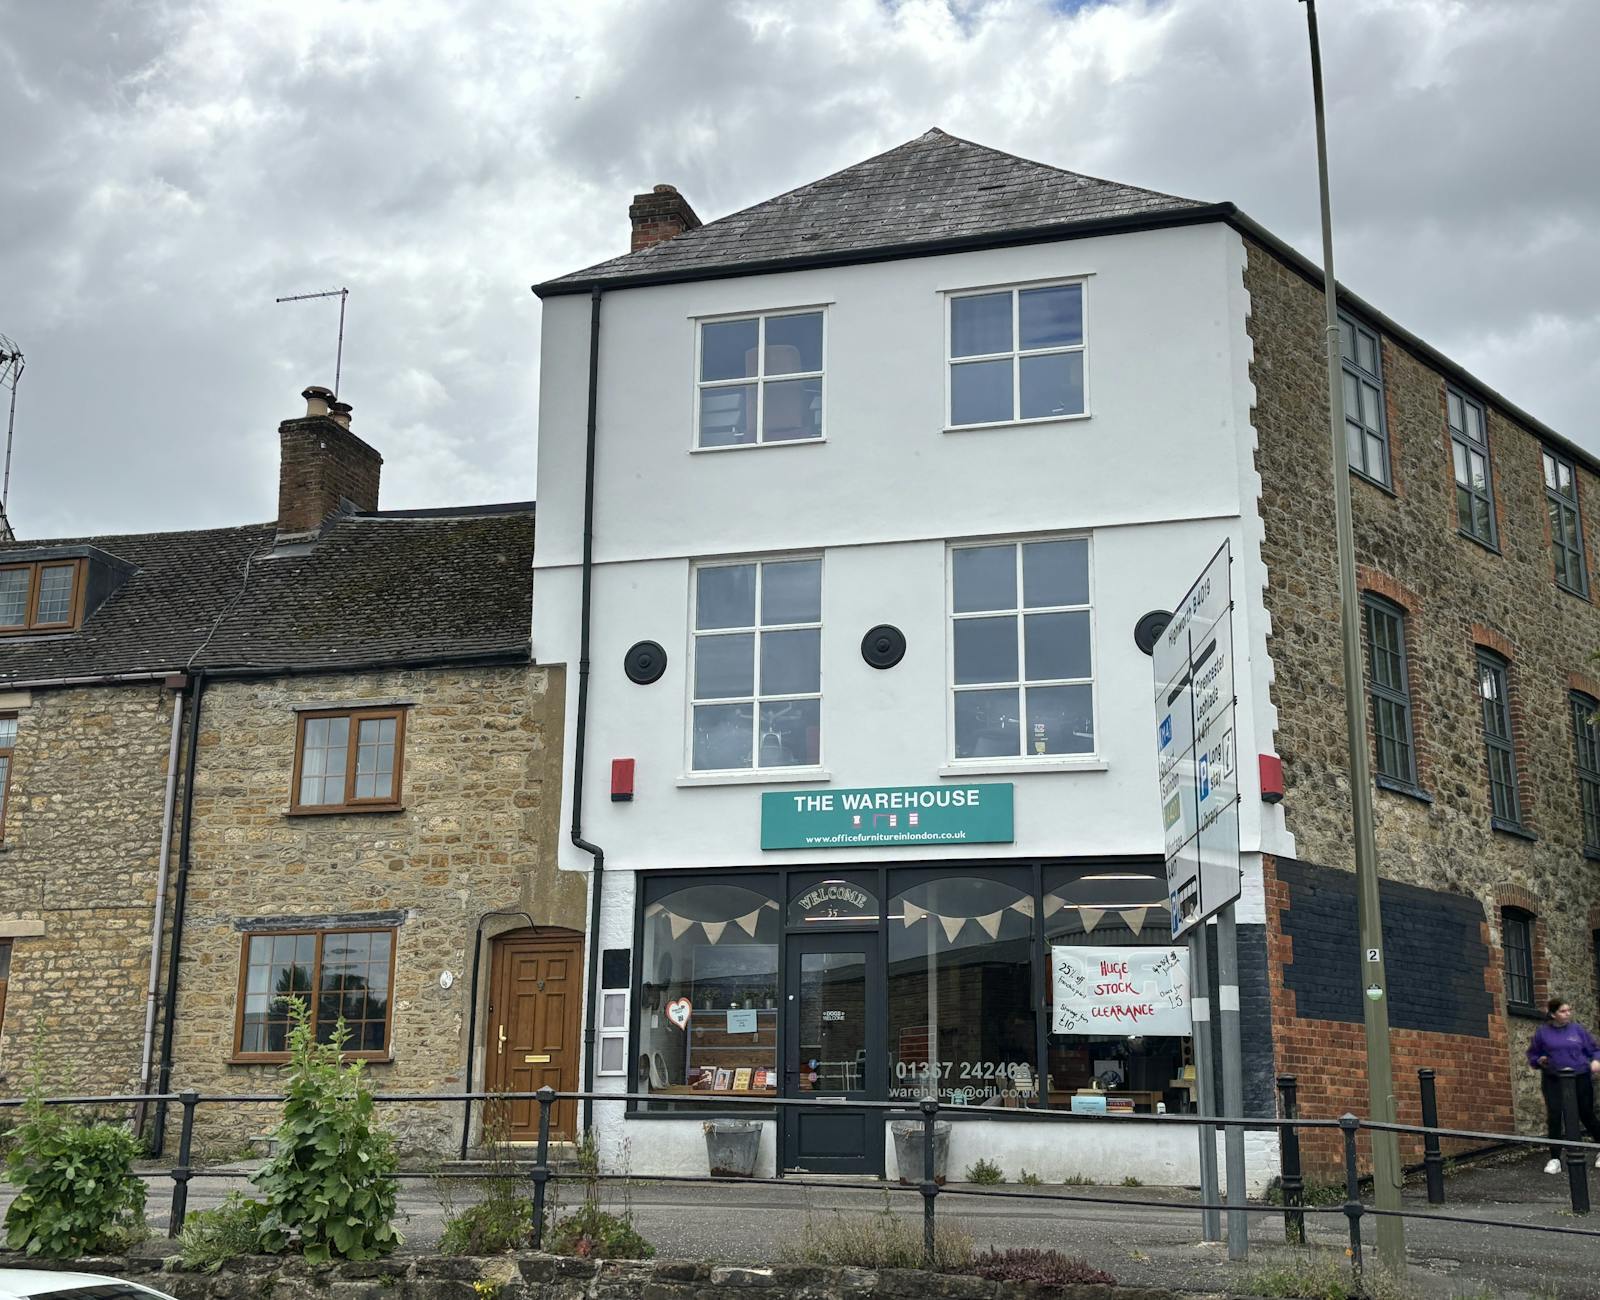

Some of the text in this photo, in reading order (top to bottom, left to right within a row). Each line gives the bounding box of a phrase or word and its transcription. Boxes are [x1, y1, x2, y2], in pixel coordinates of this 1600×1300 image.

[1196, 654, 1225, 698] Cirencester
[1209, 743, 1221, 766] Long
[1211, 768, 1221, 791] stay
[794, 790, 980, 812] THE WAREHOUSE
[1201, 804, 1219, 832] Library
[806, 831, 966, 844] www.officefurnitureinlondon.co.uk
[798, 886, 868, 910] WELCOME
[1369, 950, 1377, 960] 2
[1100, 960, 1129, 980] HUGE
[1094, 982, 1141, 996] STOCK
[1091, 1004, 1154, 1023] CLEARANCE
[896, 1062, 954, 1079] 01367
